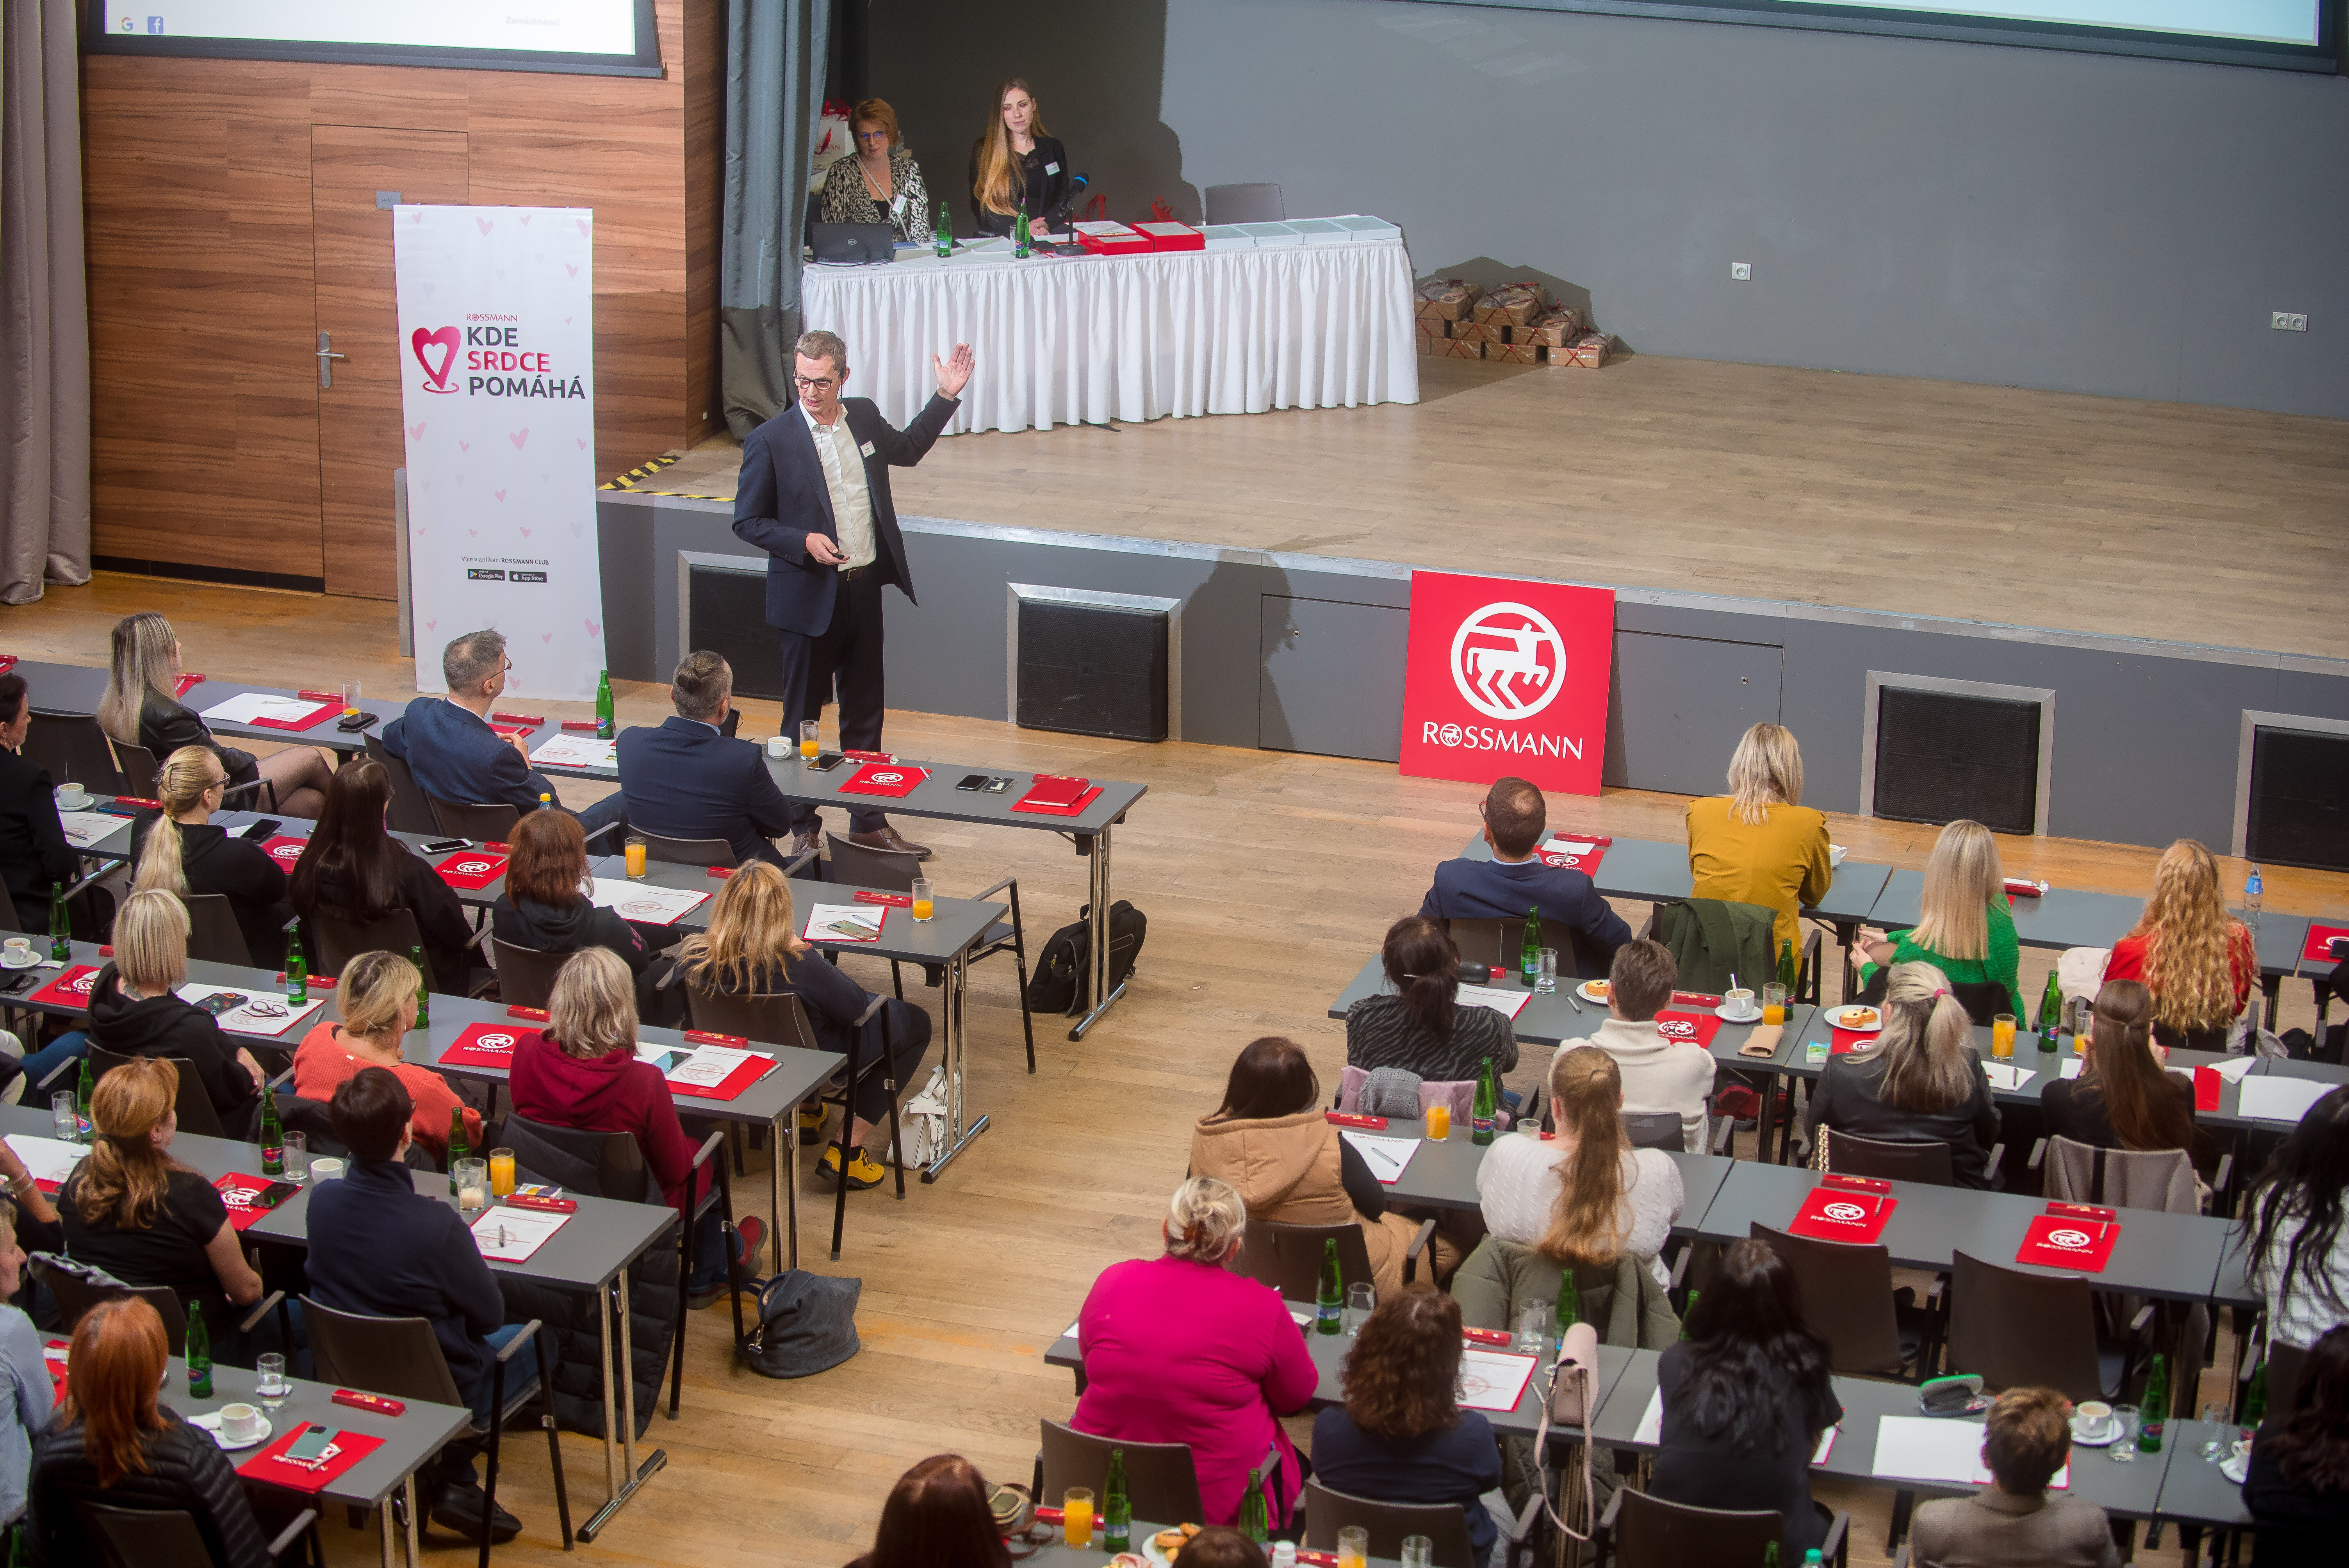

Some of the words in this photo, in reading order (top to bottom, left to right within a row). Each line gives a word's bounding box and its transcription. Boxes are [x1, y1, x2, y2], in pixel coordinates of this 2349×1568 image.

[506, 16, 560, 26] Zaměstnanci
[466, 313, 518, 322] ROSSMANN
[467, 326, 519, 347] KDE
[468, 351, 551, 373] SRDCE
[469, 374, 586, 399] POMÁHÁ
[1423, 722, 1583, 760] ROSSMANN
[441, 870, 485, 878] ROSSMANN
[462, 1046, 513, 1055] ROSSMANN
[1352, 1134, 1406, 1143] ROSSMANN
